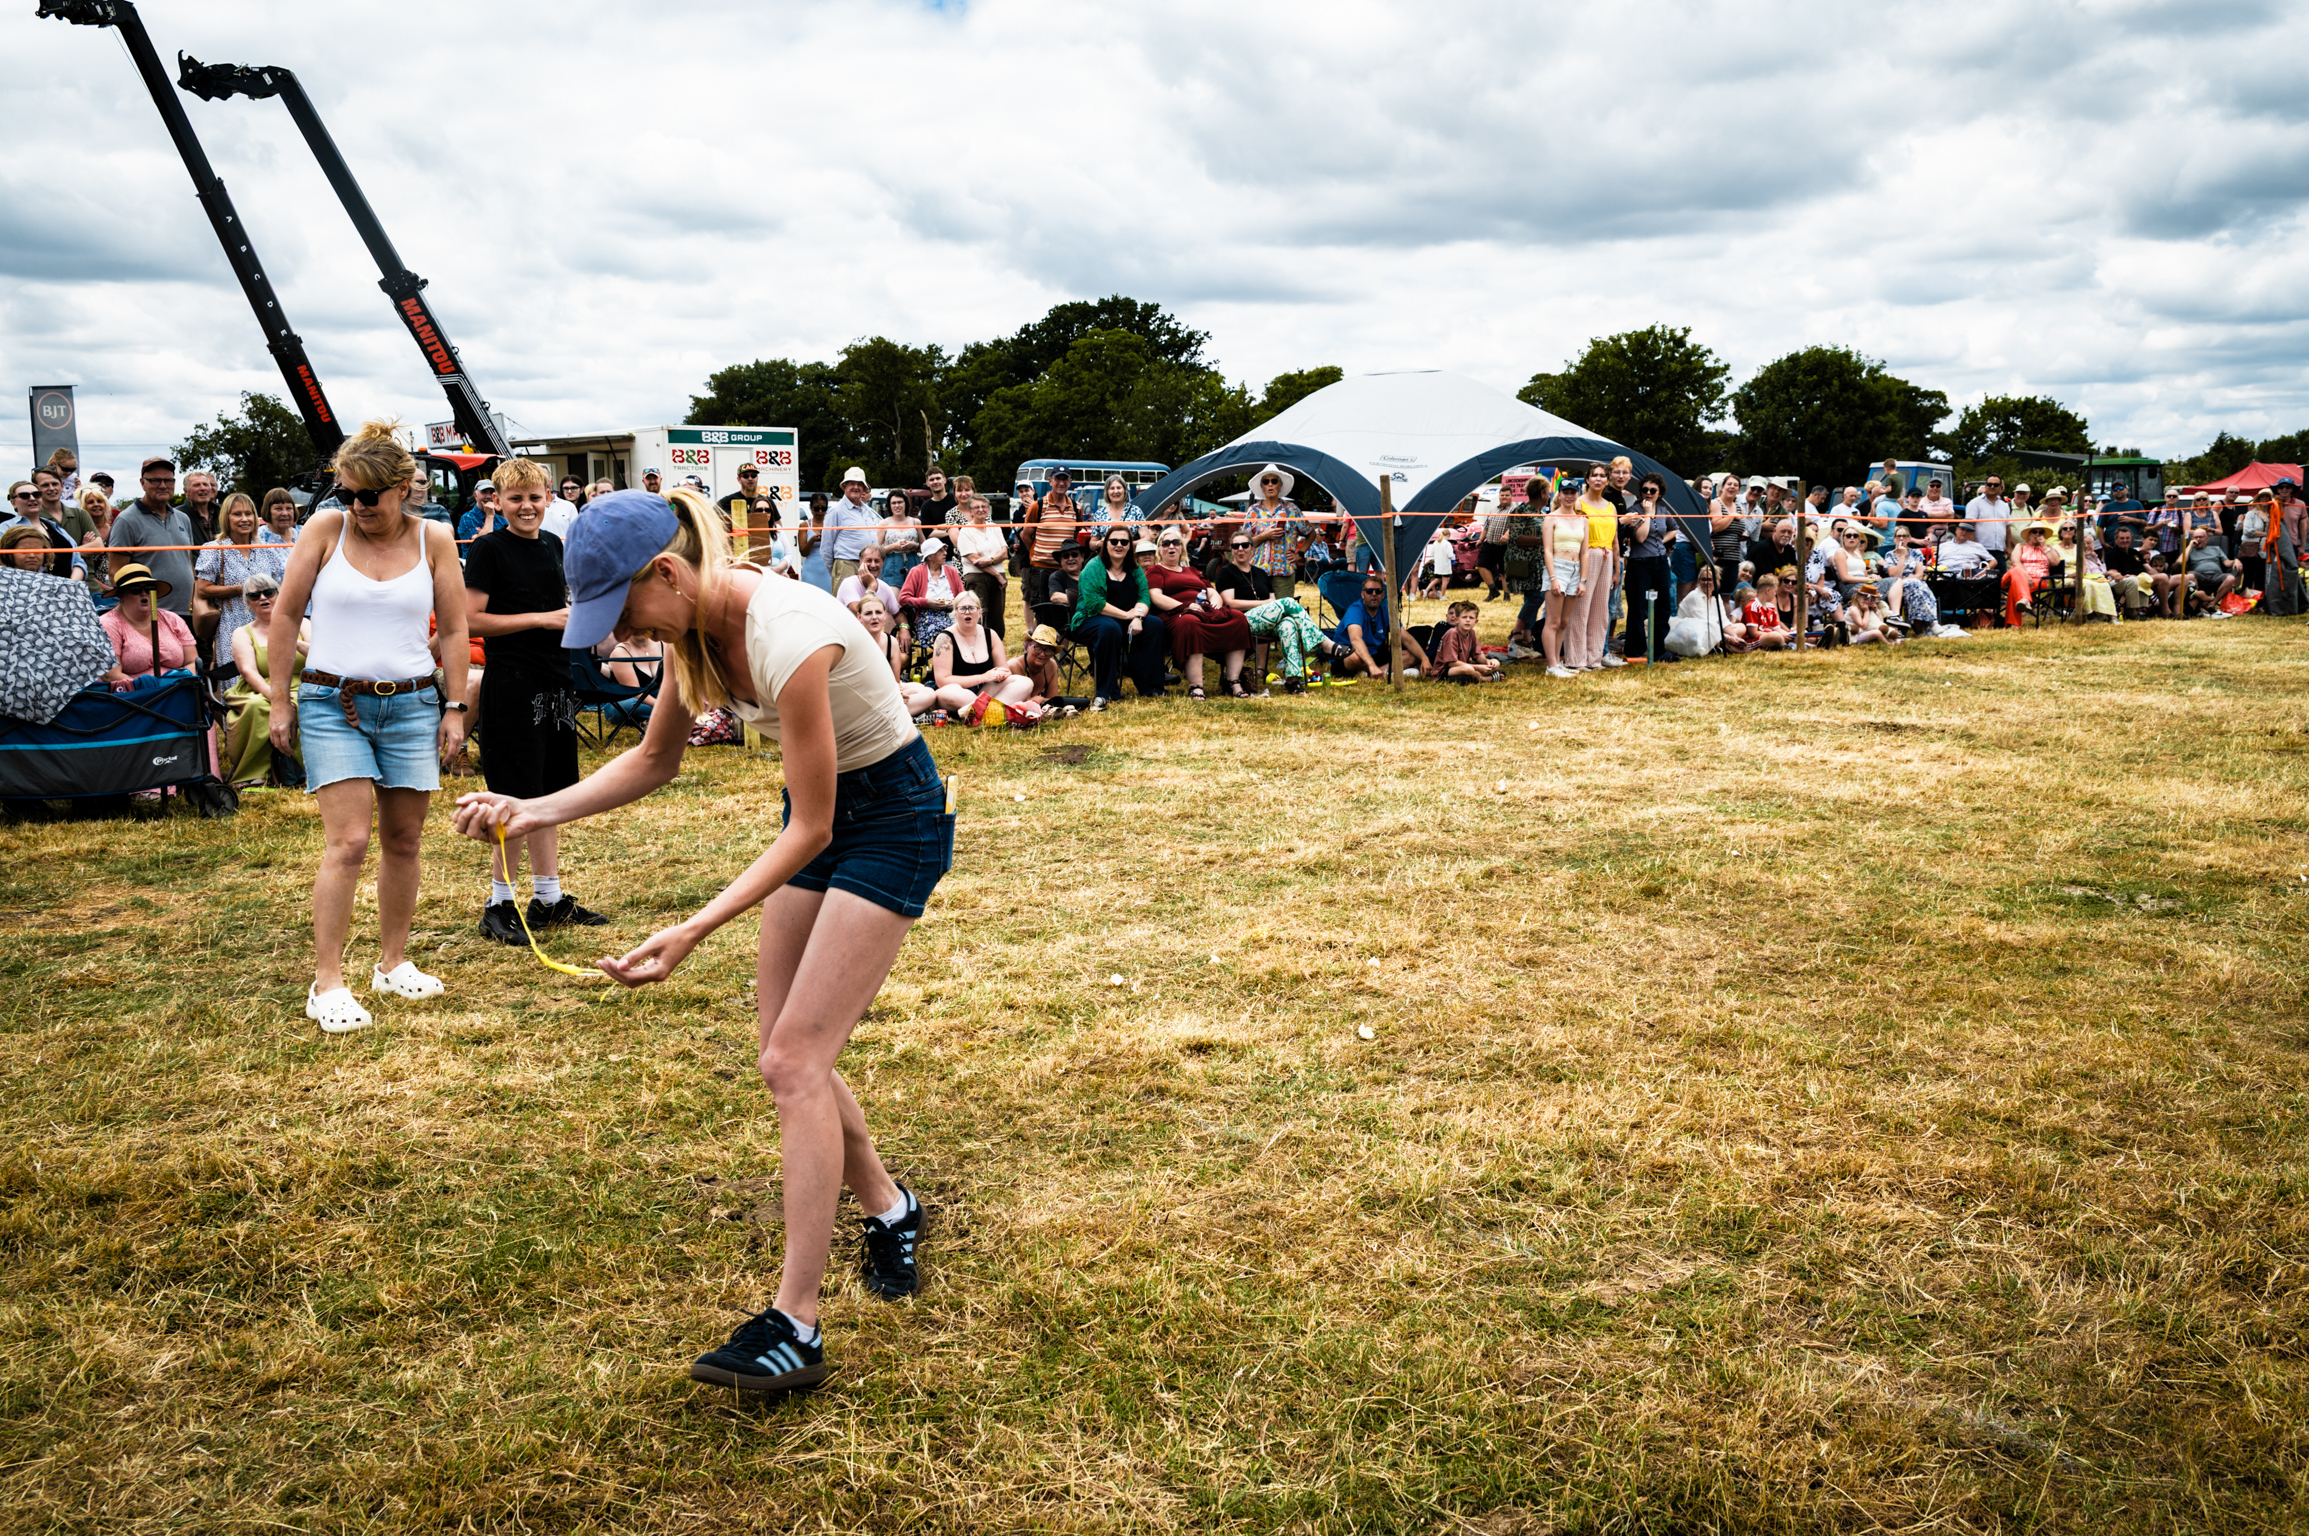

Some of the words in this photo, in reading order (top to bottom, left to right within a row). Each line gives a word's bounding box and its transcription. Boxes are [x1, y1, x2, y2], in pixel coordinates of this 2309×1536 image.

[226, 215, 233, 223] A
[254, 273, 261, 281] C
[280, 329, 287, 337] E
[400, 297, 456, 374] MANITOU
[297, 364, 331, 423] MANITOU
[42, 405, 67, 419] BJT
[701, 431, 729, 444] B&B
[730, 434, 763, 442] GROUP
[671, 448, 710, 465] B&B
[755, 450, 792, 466] B&B
